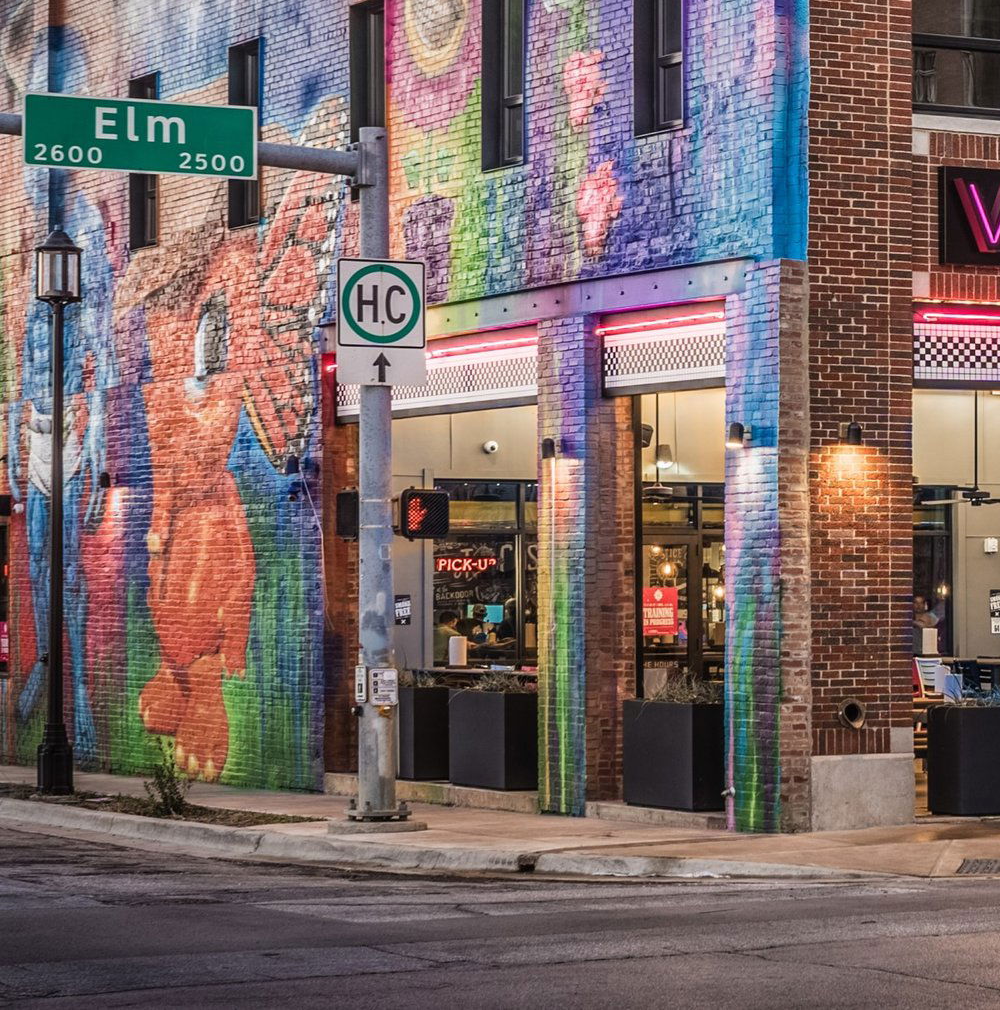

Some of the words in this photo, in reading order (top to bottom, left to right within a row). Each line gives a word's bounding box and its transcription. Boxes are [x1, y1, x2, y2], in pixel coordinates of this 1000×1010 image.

[95, 105, 186, 144] Elm
[34, 143, 102, 165] 2600
[179, 152, 245, 173] 2500
